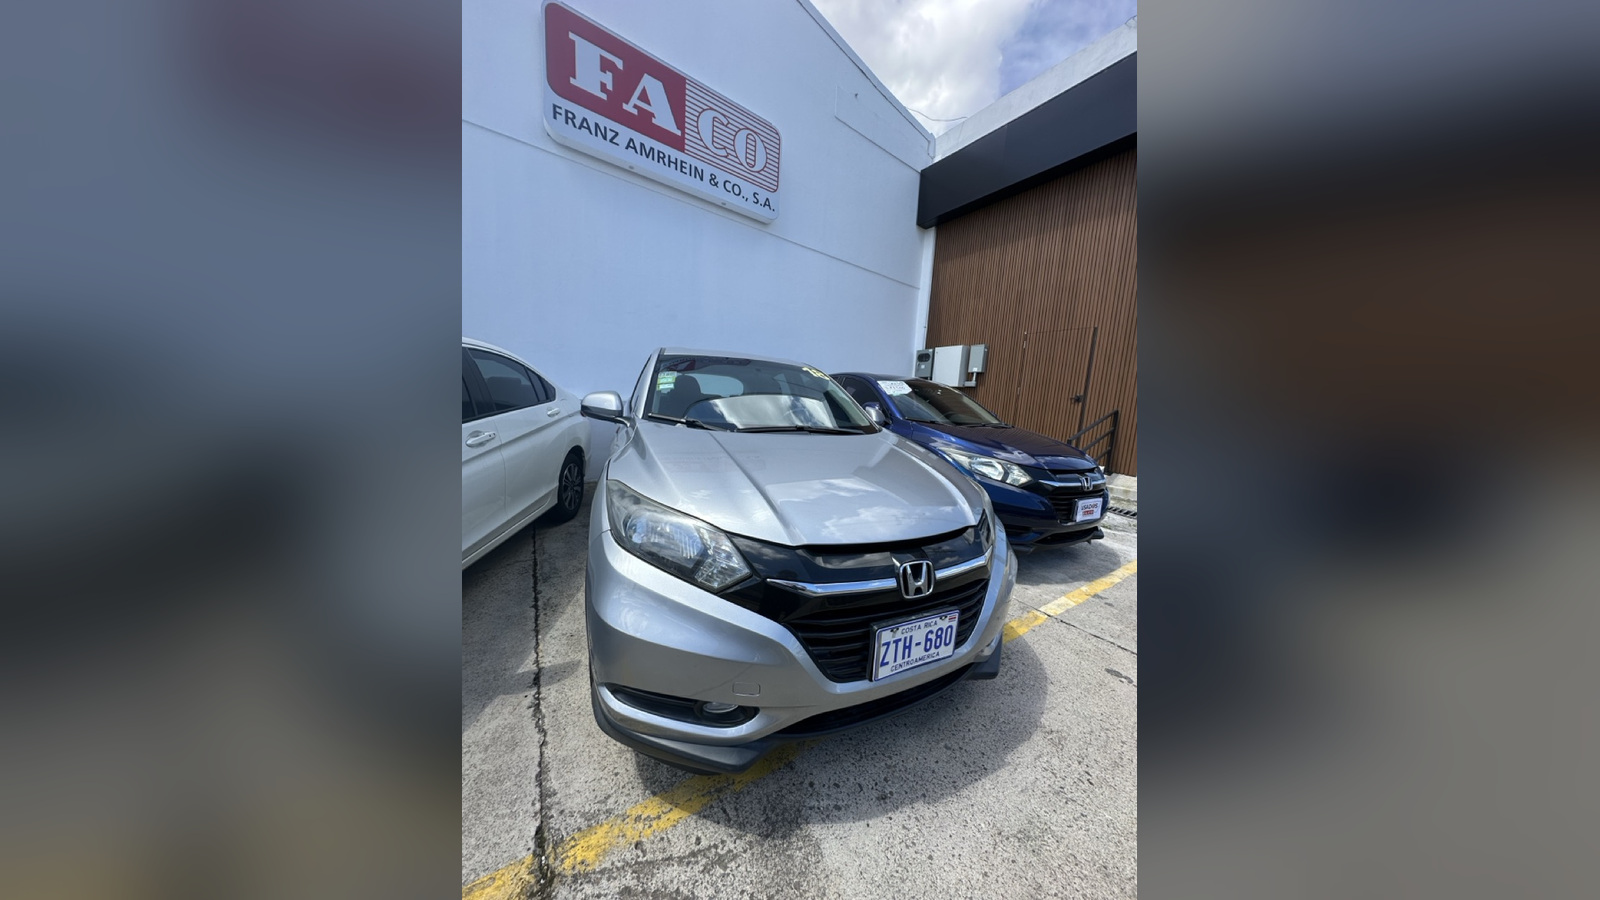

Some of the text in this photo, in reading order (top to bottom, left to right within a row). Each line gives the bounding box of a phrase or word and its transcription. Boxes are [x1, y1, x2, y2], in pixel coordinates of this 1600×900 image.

[552, 103, 620, 146] FRANZ
[625, 137, 704, 182] AMRHEIN
[709, 173, 719, 188] &
[752, 192, 775, 211] S.A.
[901, 620, 938, 634] COSTA RICA
[880, 625, 954, 667] ZTH-680
[890, 651, 940, 672] CENTROAMERICA
